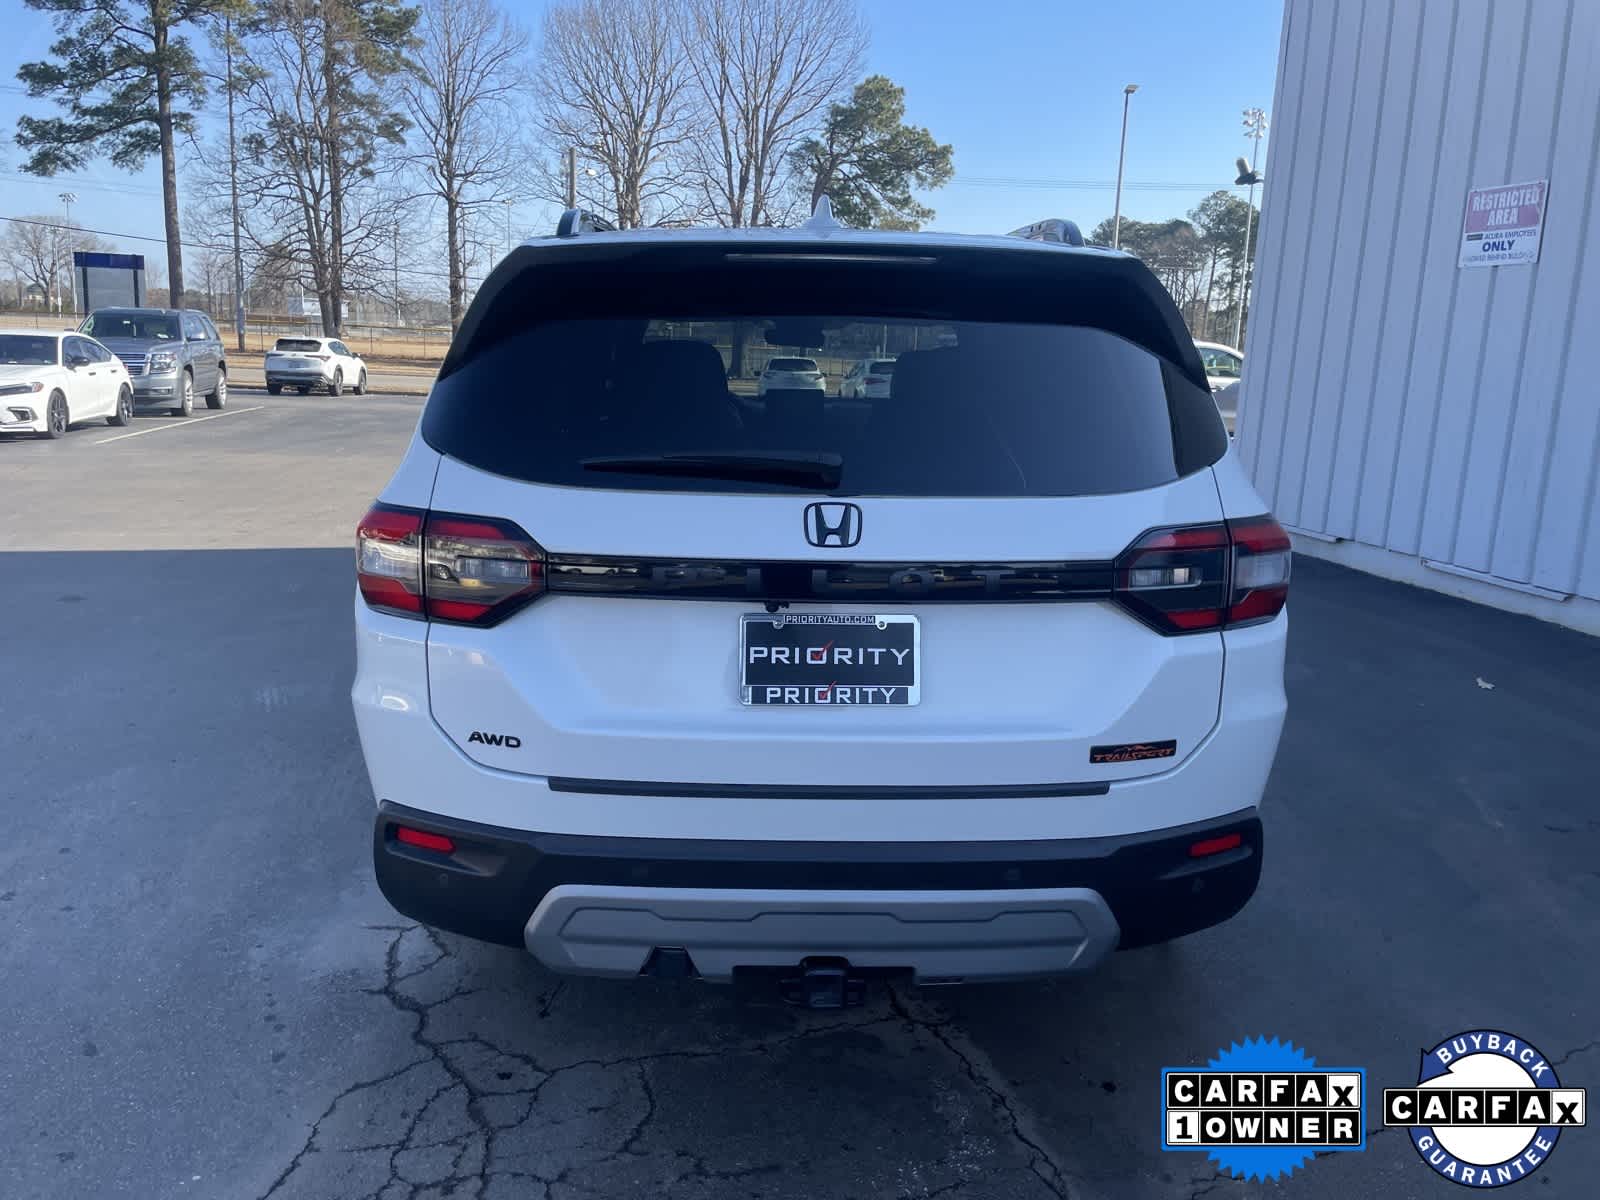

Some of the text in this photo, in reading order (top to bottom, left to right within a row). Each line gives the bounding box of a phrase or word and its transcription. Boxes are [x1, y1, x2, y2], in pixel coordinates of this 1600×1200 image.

[1472, 188, 1540, 212] RESTRICTED
[1487, 207, 1519, 226] AREA
[1482, 239, 1516, 252] ONLY
[785, 614, 876, 624] PRIORITYAUTO.COM
[749, 646, 910, 666] PRIORITY
[766, 687, 896, 704] PRIORITY
[467, 731, 522, 748] AWD
